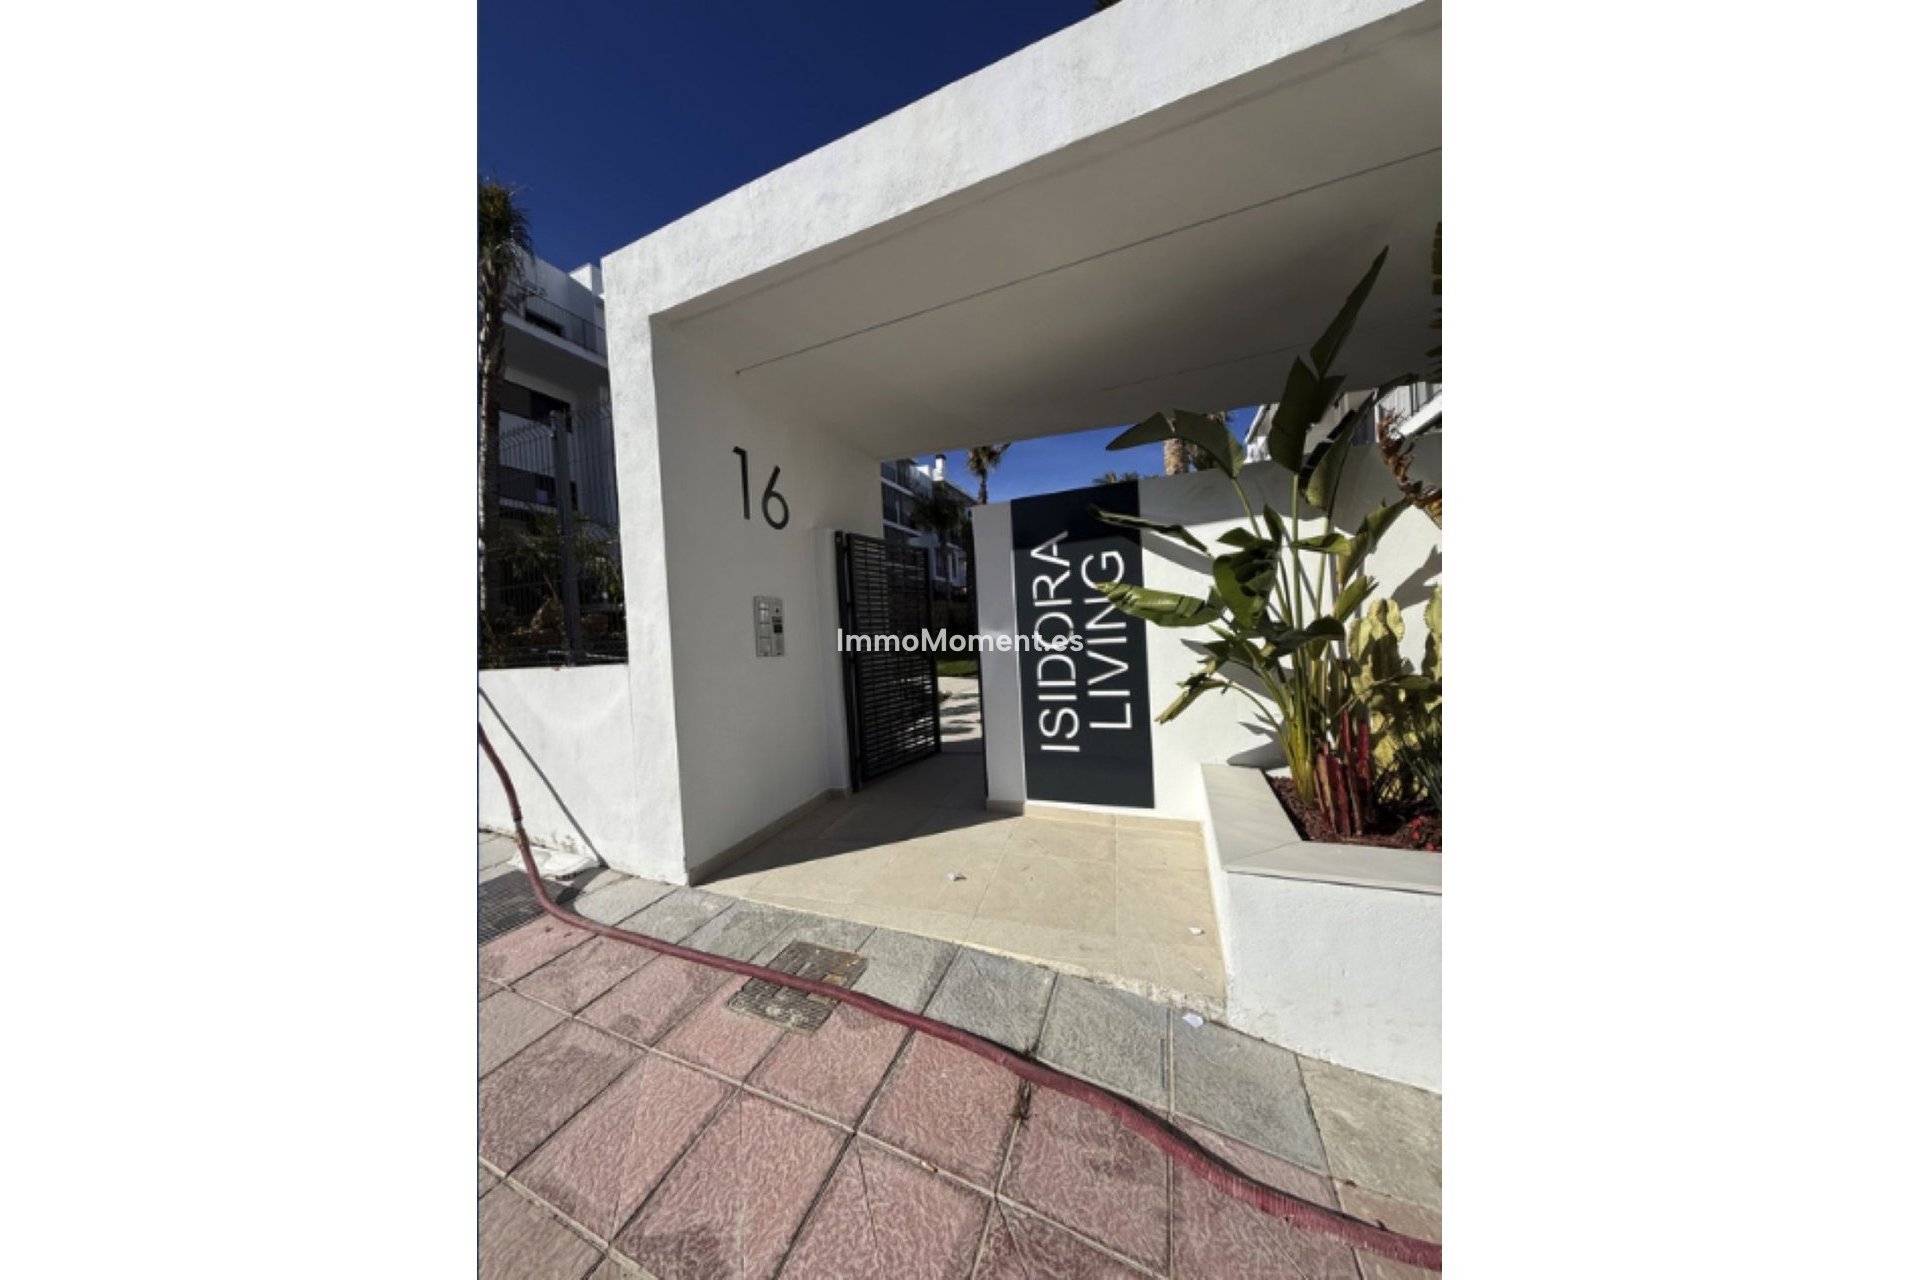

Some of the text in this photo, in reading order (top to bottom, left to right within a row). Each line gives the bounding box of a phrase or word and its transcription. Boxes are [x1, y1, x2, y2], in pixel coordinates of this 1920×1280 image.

[732, 446, 789, 530] 16
[1030, 530, 1080, 752] ISIDORA
[1081, 550, 1133, 730] LIVING
